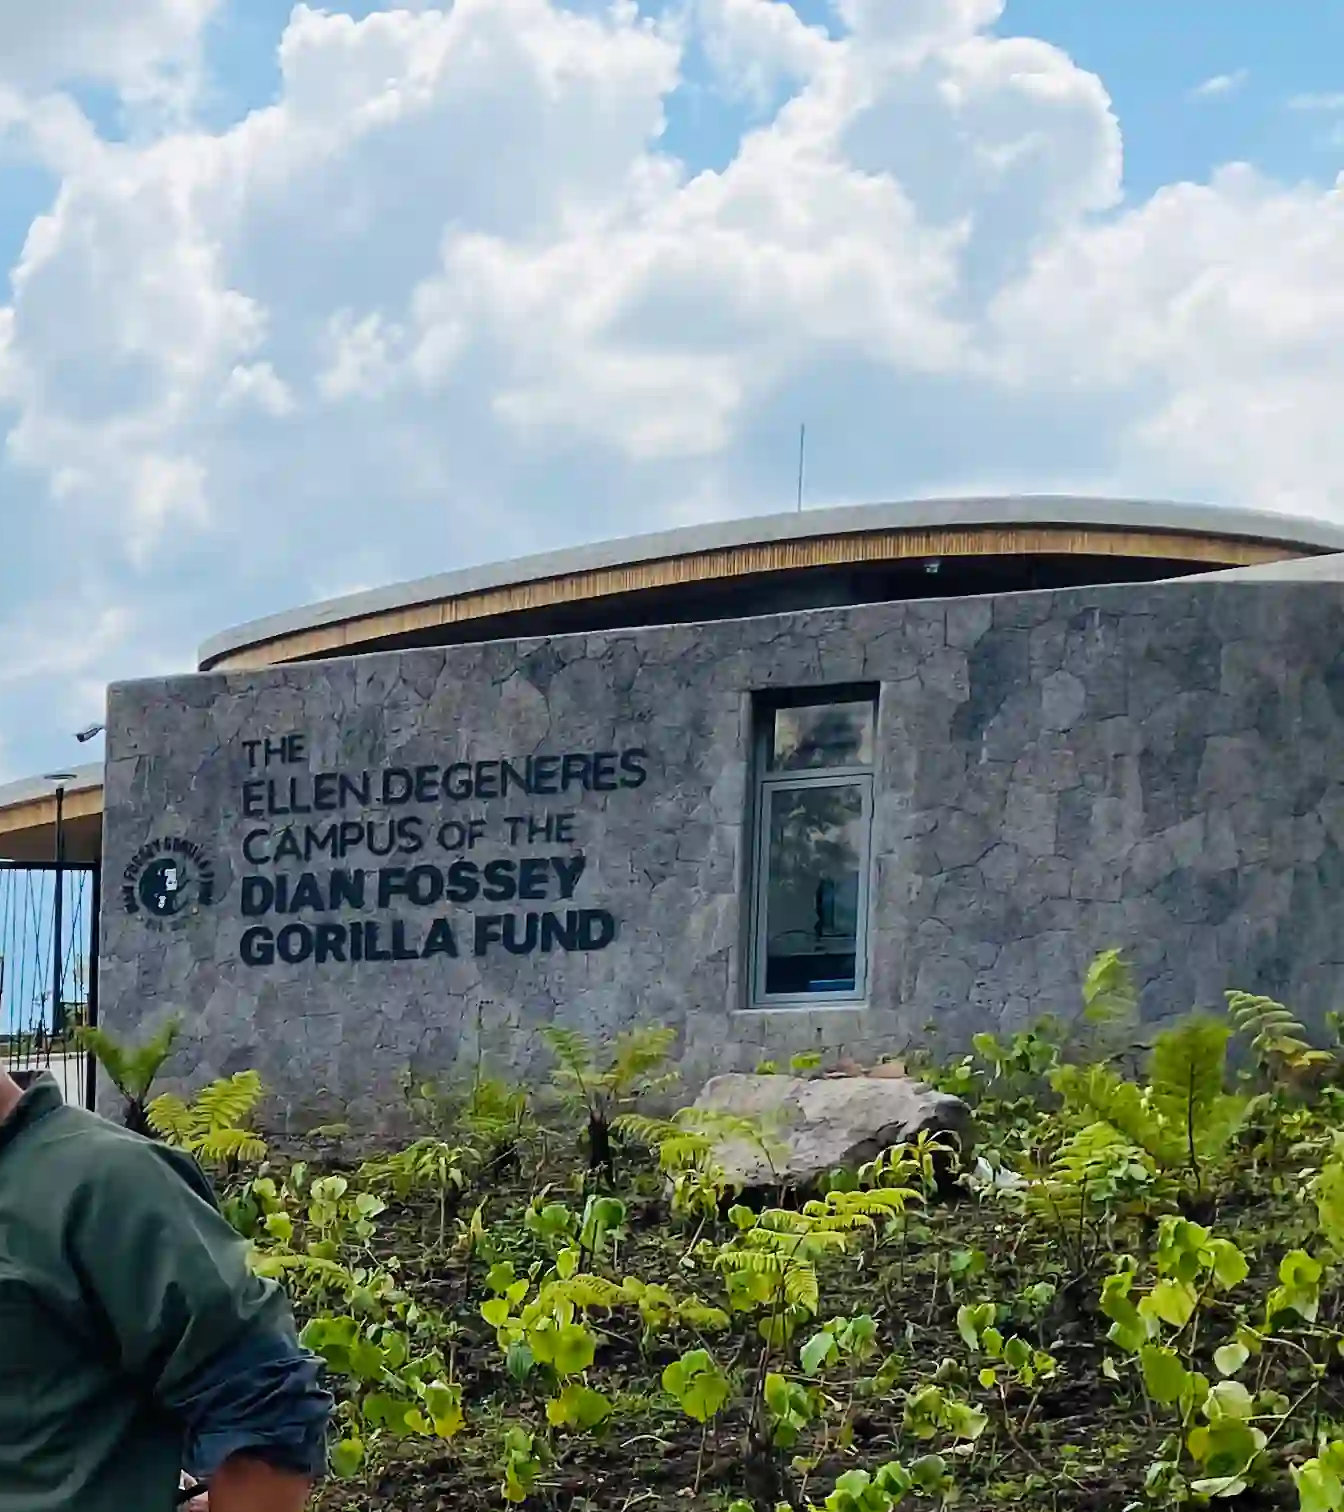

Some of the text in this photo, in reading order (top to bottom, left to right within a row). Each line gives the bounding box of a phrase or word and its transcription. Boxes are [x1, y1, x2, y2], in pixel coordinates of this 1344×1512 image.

[242, 734, 308, 768] THE
[242, 748, 649, 818] ELLEN DEGENERES
[242, 812, 578, 866] CAMPUS OF THE
[240, 867, 365, 917] DIAN
[377, 854, 587, 908] FOSSEY
[239, 908, 616, 967] GORILLA FUND
